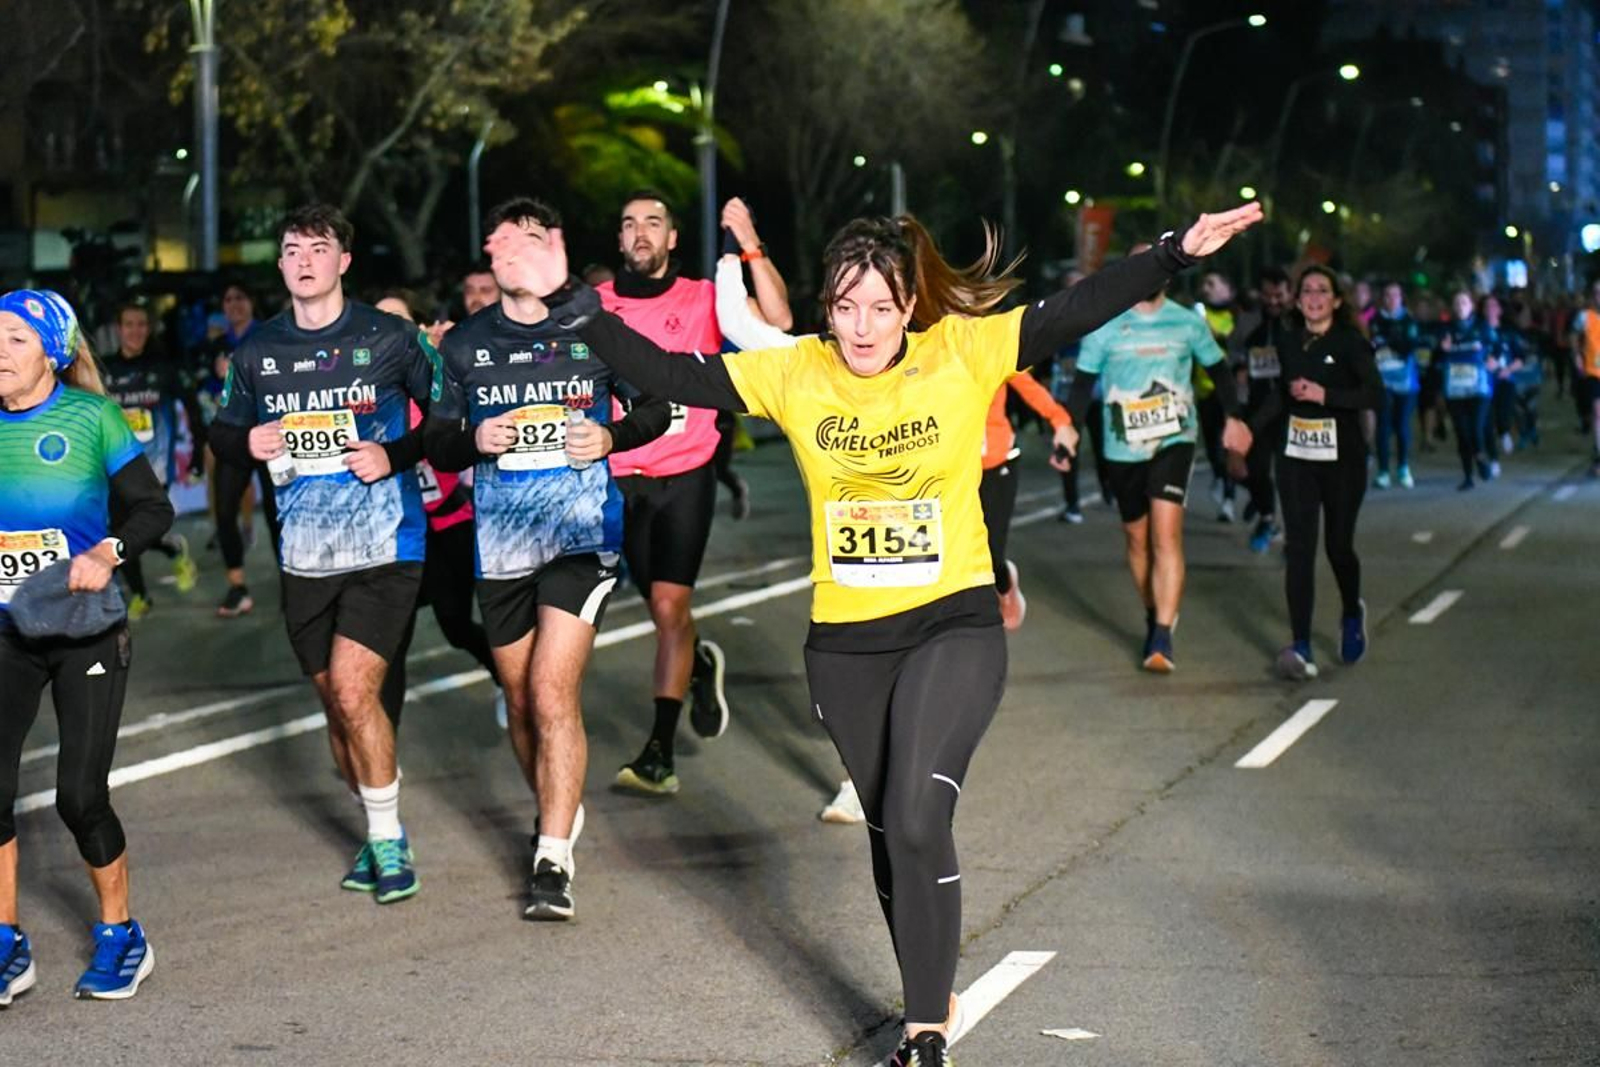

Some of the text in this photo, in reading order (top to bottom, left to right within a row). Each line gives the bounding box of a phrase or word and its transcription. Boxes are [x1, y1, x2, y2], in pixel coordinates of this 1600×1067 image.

[264, 378, 376, 413] SAN ANTÓN
[476, 375, 594, 405] SAN ANTÓN
[829, 415, 939, 452] MELONERA
[836, 416, 860, 433] LA
[285, 428, 350, 452] 9896
[877, 432, 940, 459] TRIBOOST
[850, 507, 869, 521] 42
[838, 525, 932, 555] 3154
